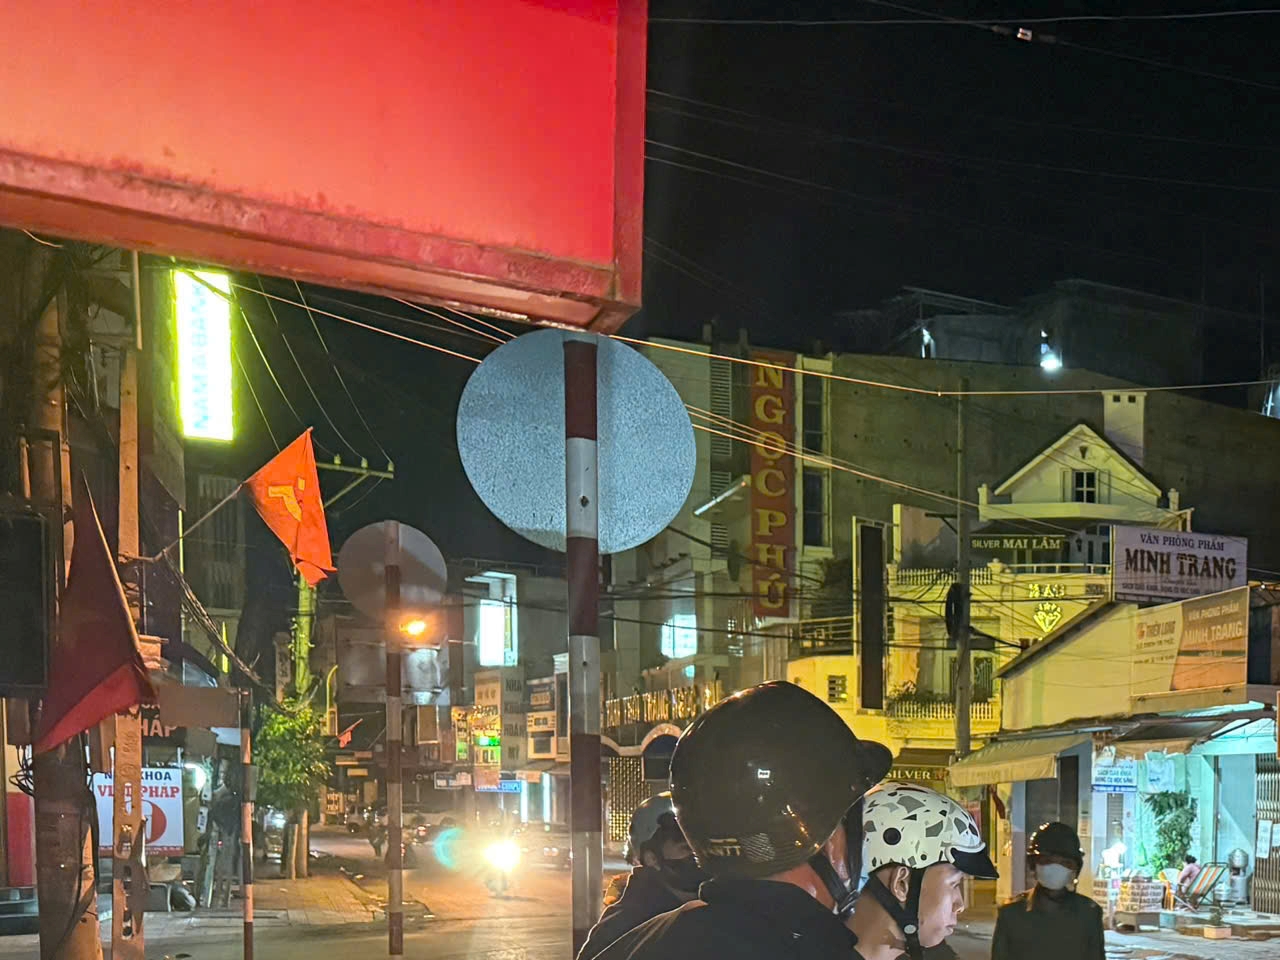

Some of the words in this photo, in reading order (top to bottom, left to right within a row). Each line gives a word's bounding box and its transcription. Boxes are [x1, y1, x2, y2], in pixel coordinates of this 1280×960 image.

[971, 539, 1001, 549] SILVER
[1002, 538, 1029, 549] MAI
[1140, 533, 1160, 546] VĂN
[1162, 535, 1196, 550] PHÒNG
[1125, 547, 1172, 576] MINH
[1176, 552, 1237, 580] TRANG
[1210, 621, 1243, 641] TRANG
